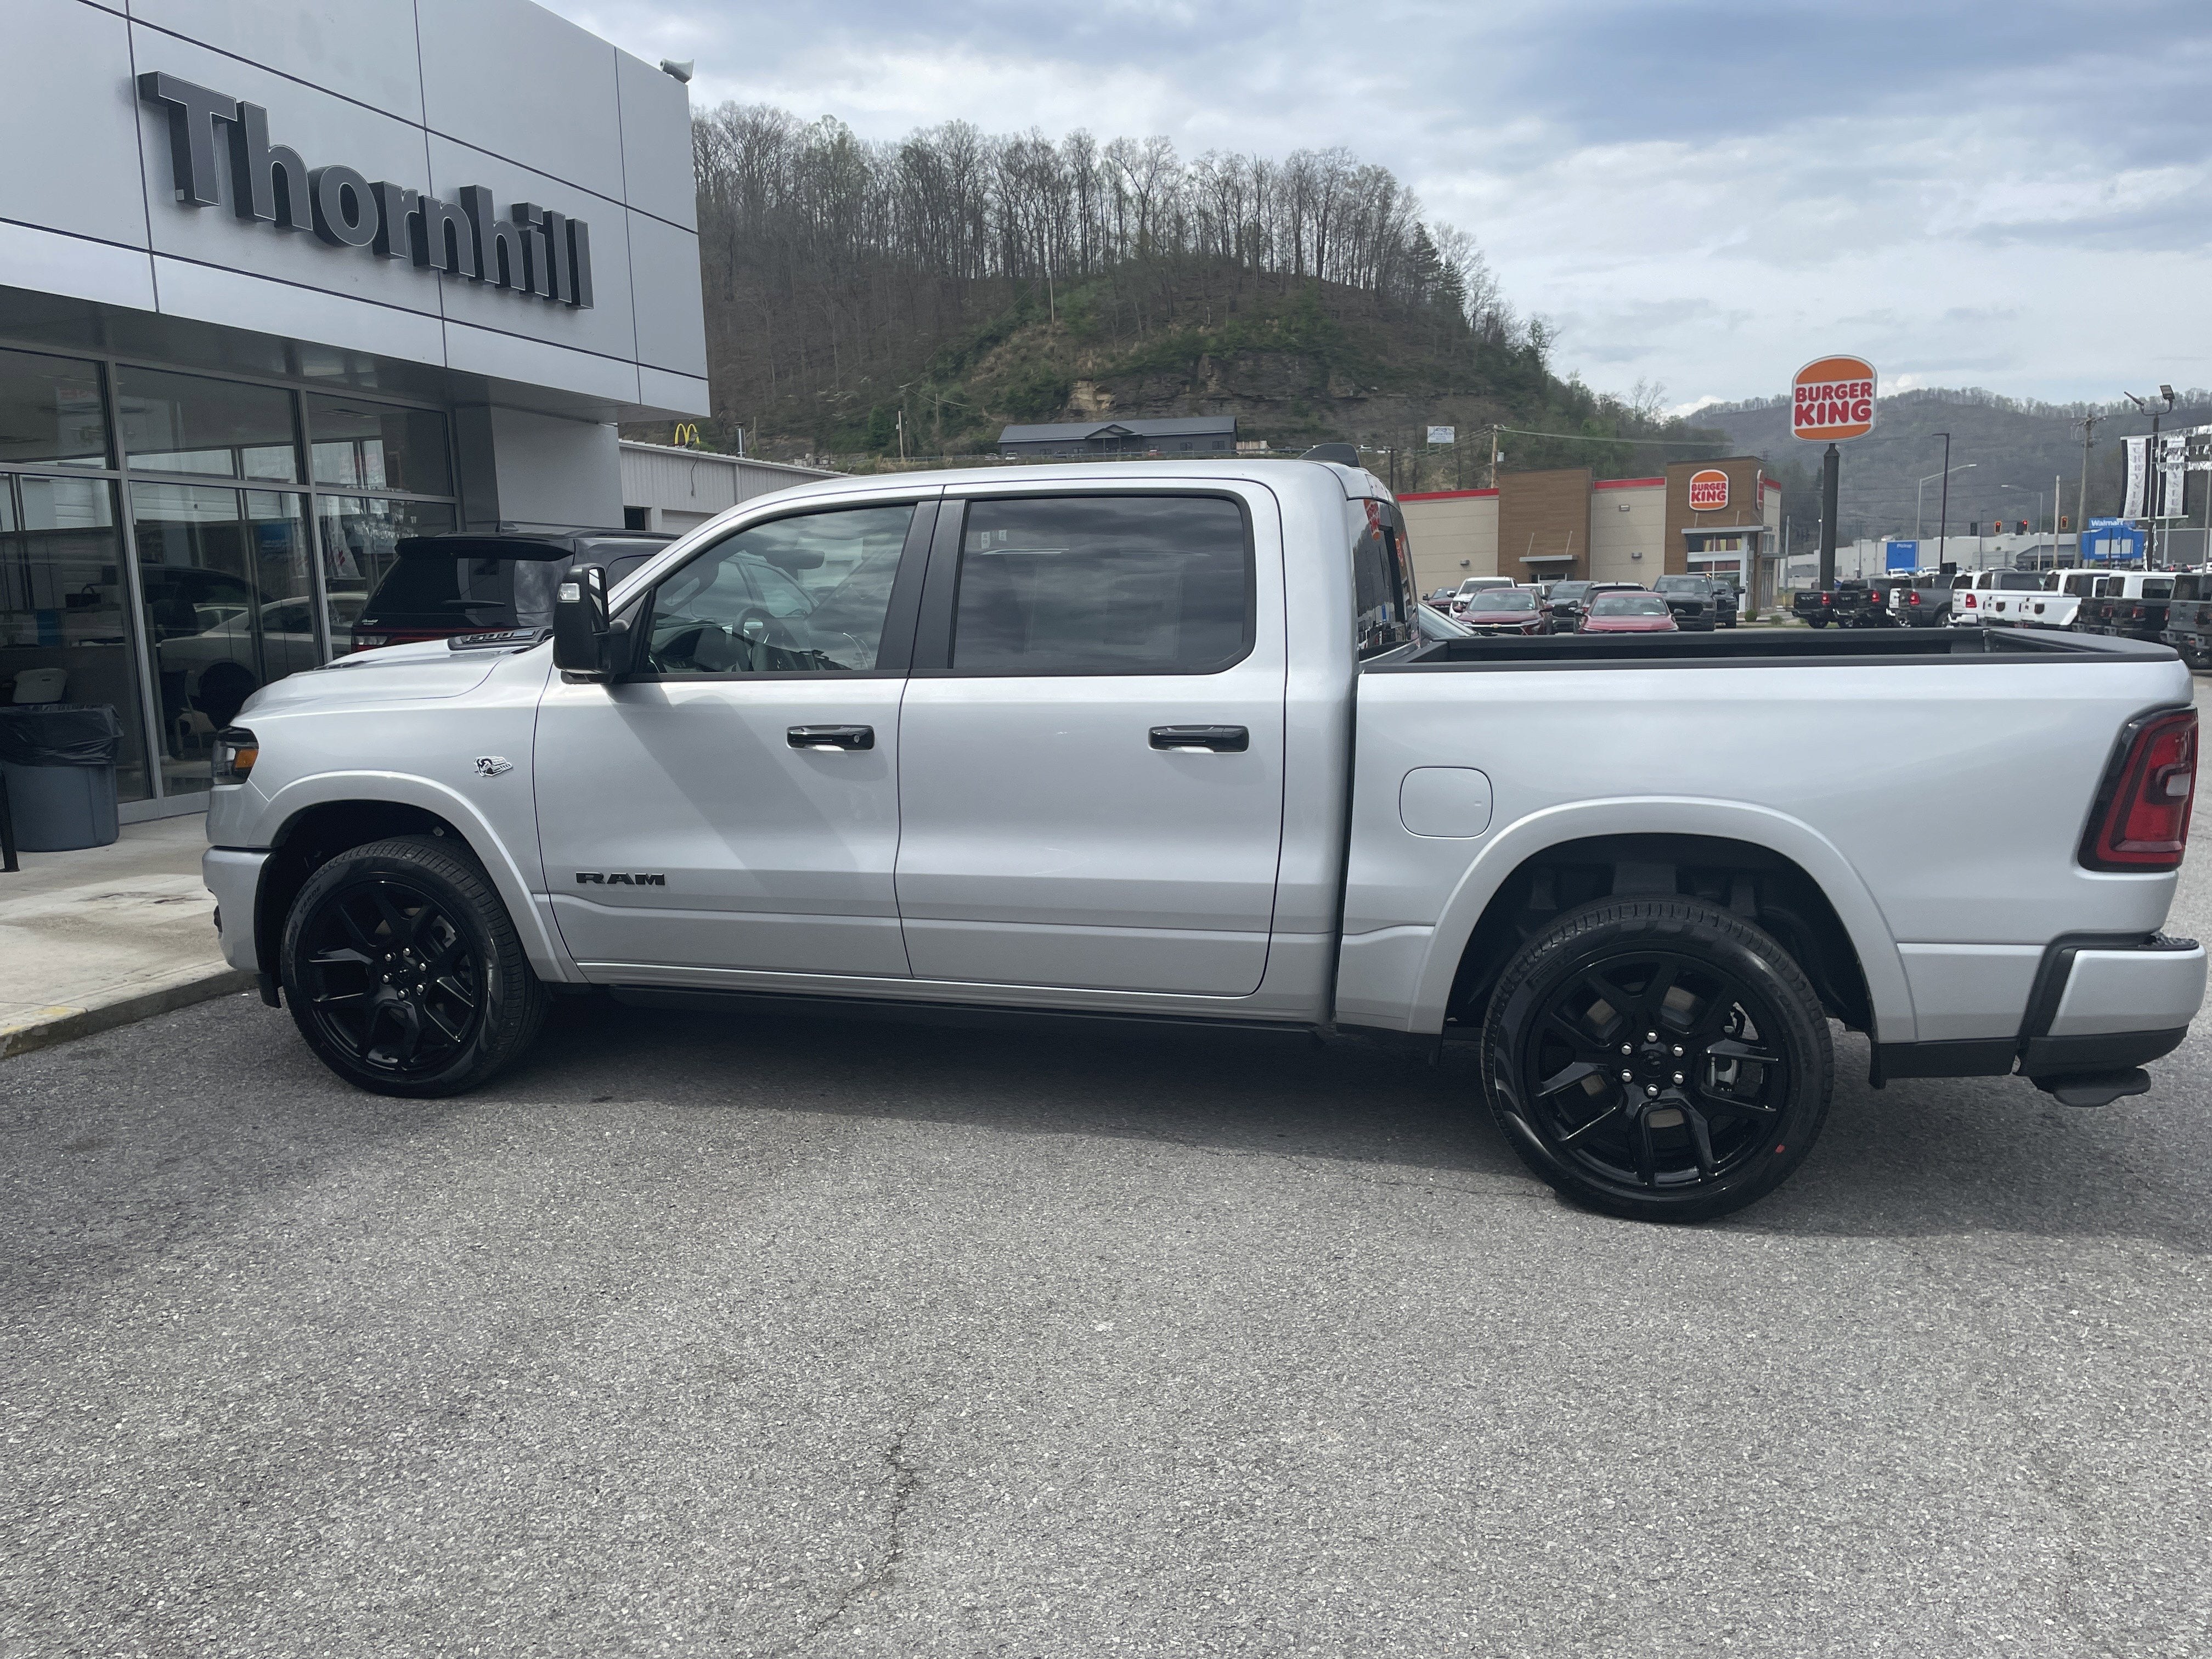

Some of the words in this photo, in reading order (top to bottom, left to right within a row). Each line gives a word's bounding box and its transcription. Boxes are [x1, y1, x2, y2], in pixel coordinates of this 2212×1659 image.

[138, 71, 594, 311] Thornhill
[1795, 382, 1872, 403] BURGER
[1795, 399, 1872, 426] KING
[1691, 483, 1726, 491] BURGER
[1691, 490, 1726, 502] KING
[575, 871, 665, 885] RAM
